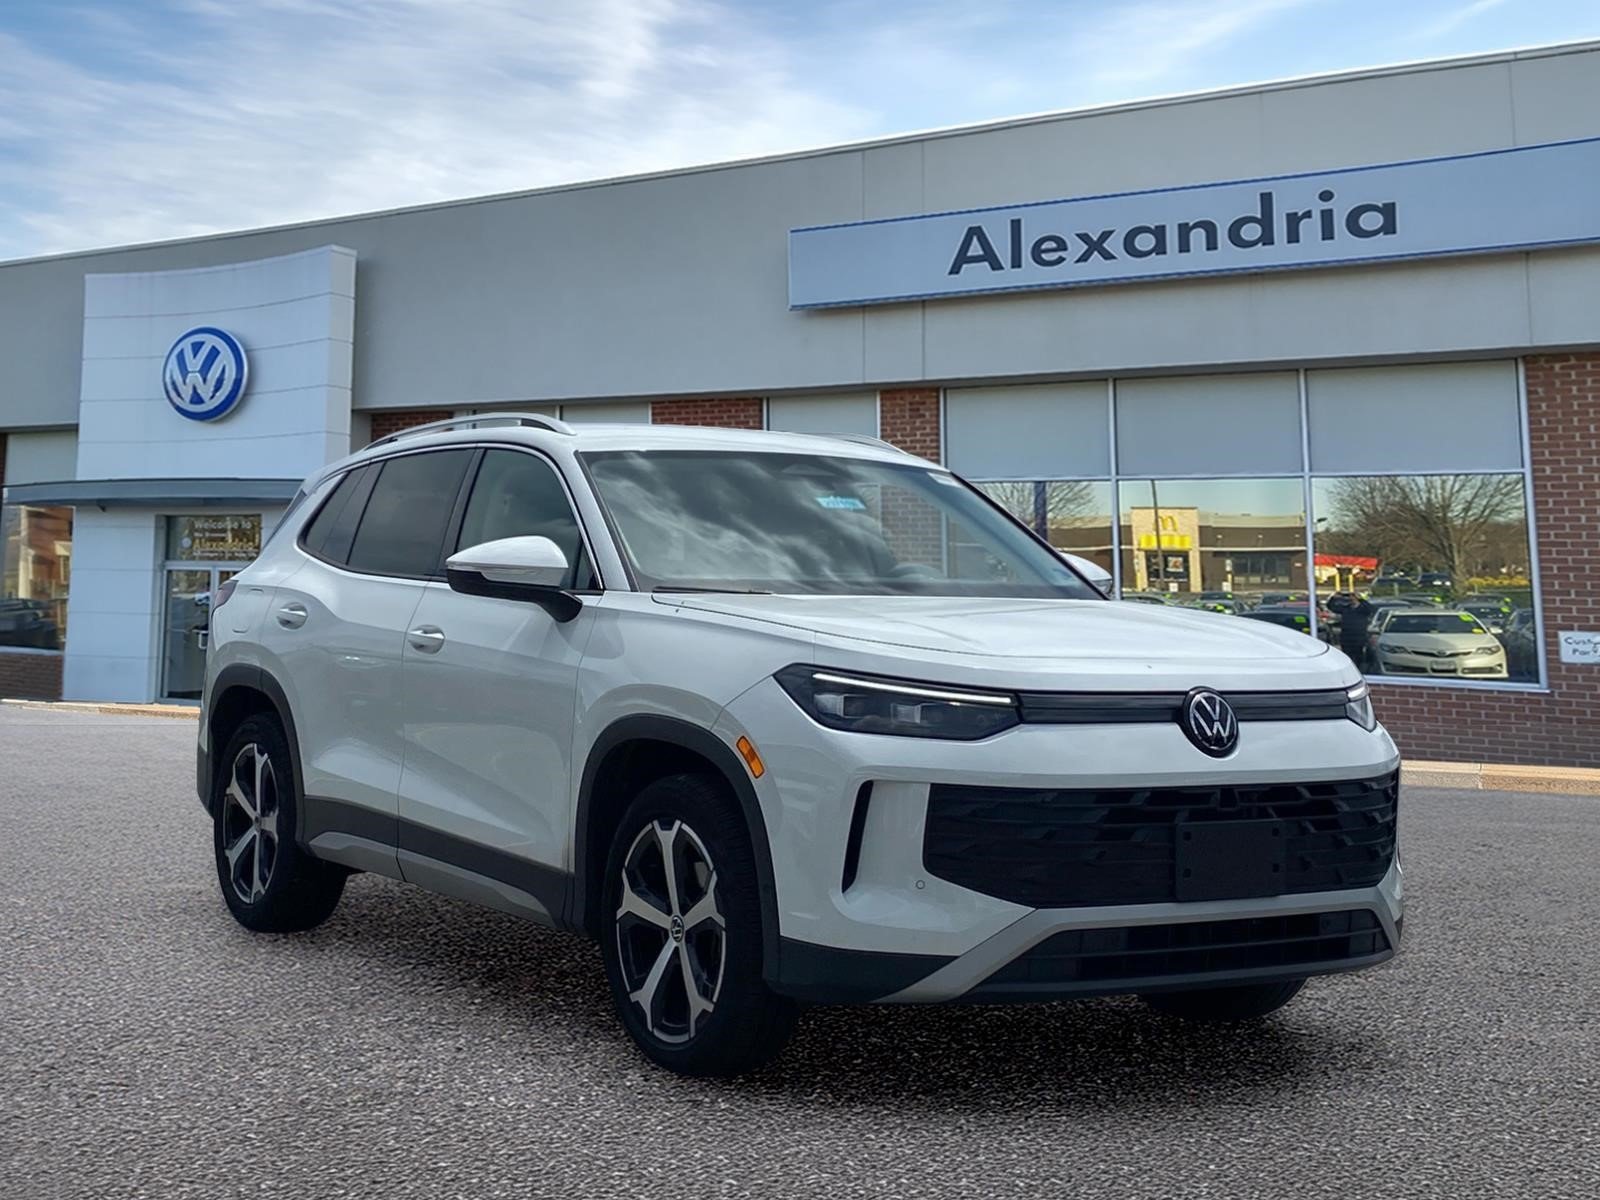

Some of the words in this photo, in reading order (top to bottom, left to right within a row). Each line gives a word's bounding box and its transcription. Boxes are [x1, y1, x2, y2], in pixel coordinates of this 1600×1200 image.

[947, 190, 1398, 276] Alexandria
[194, 519, 239, 529] Welcome
[1189, 691, 1237, 751] VW
